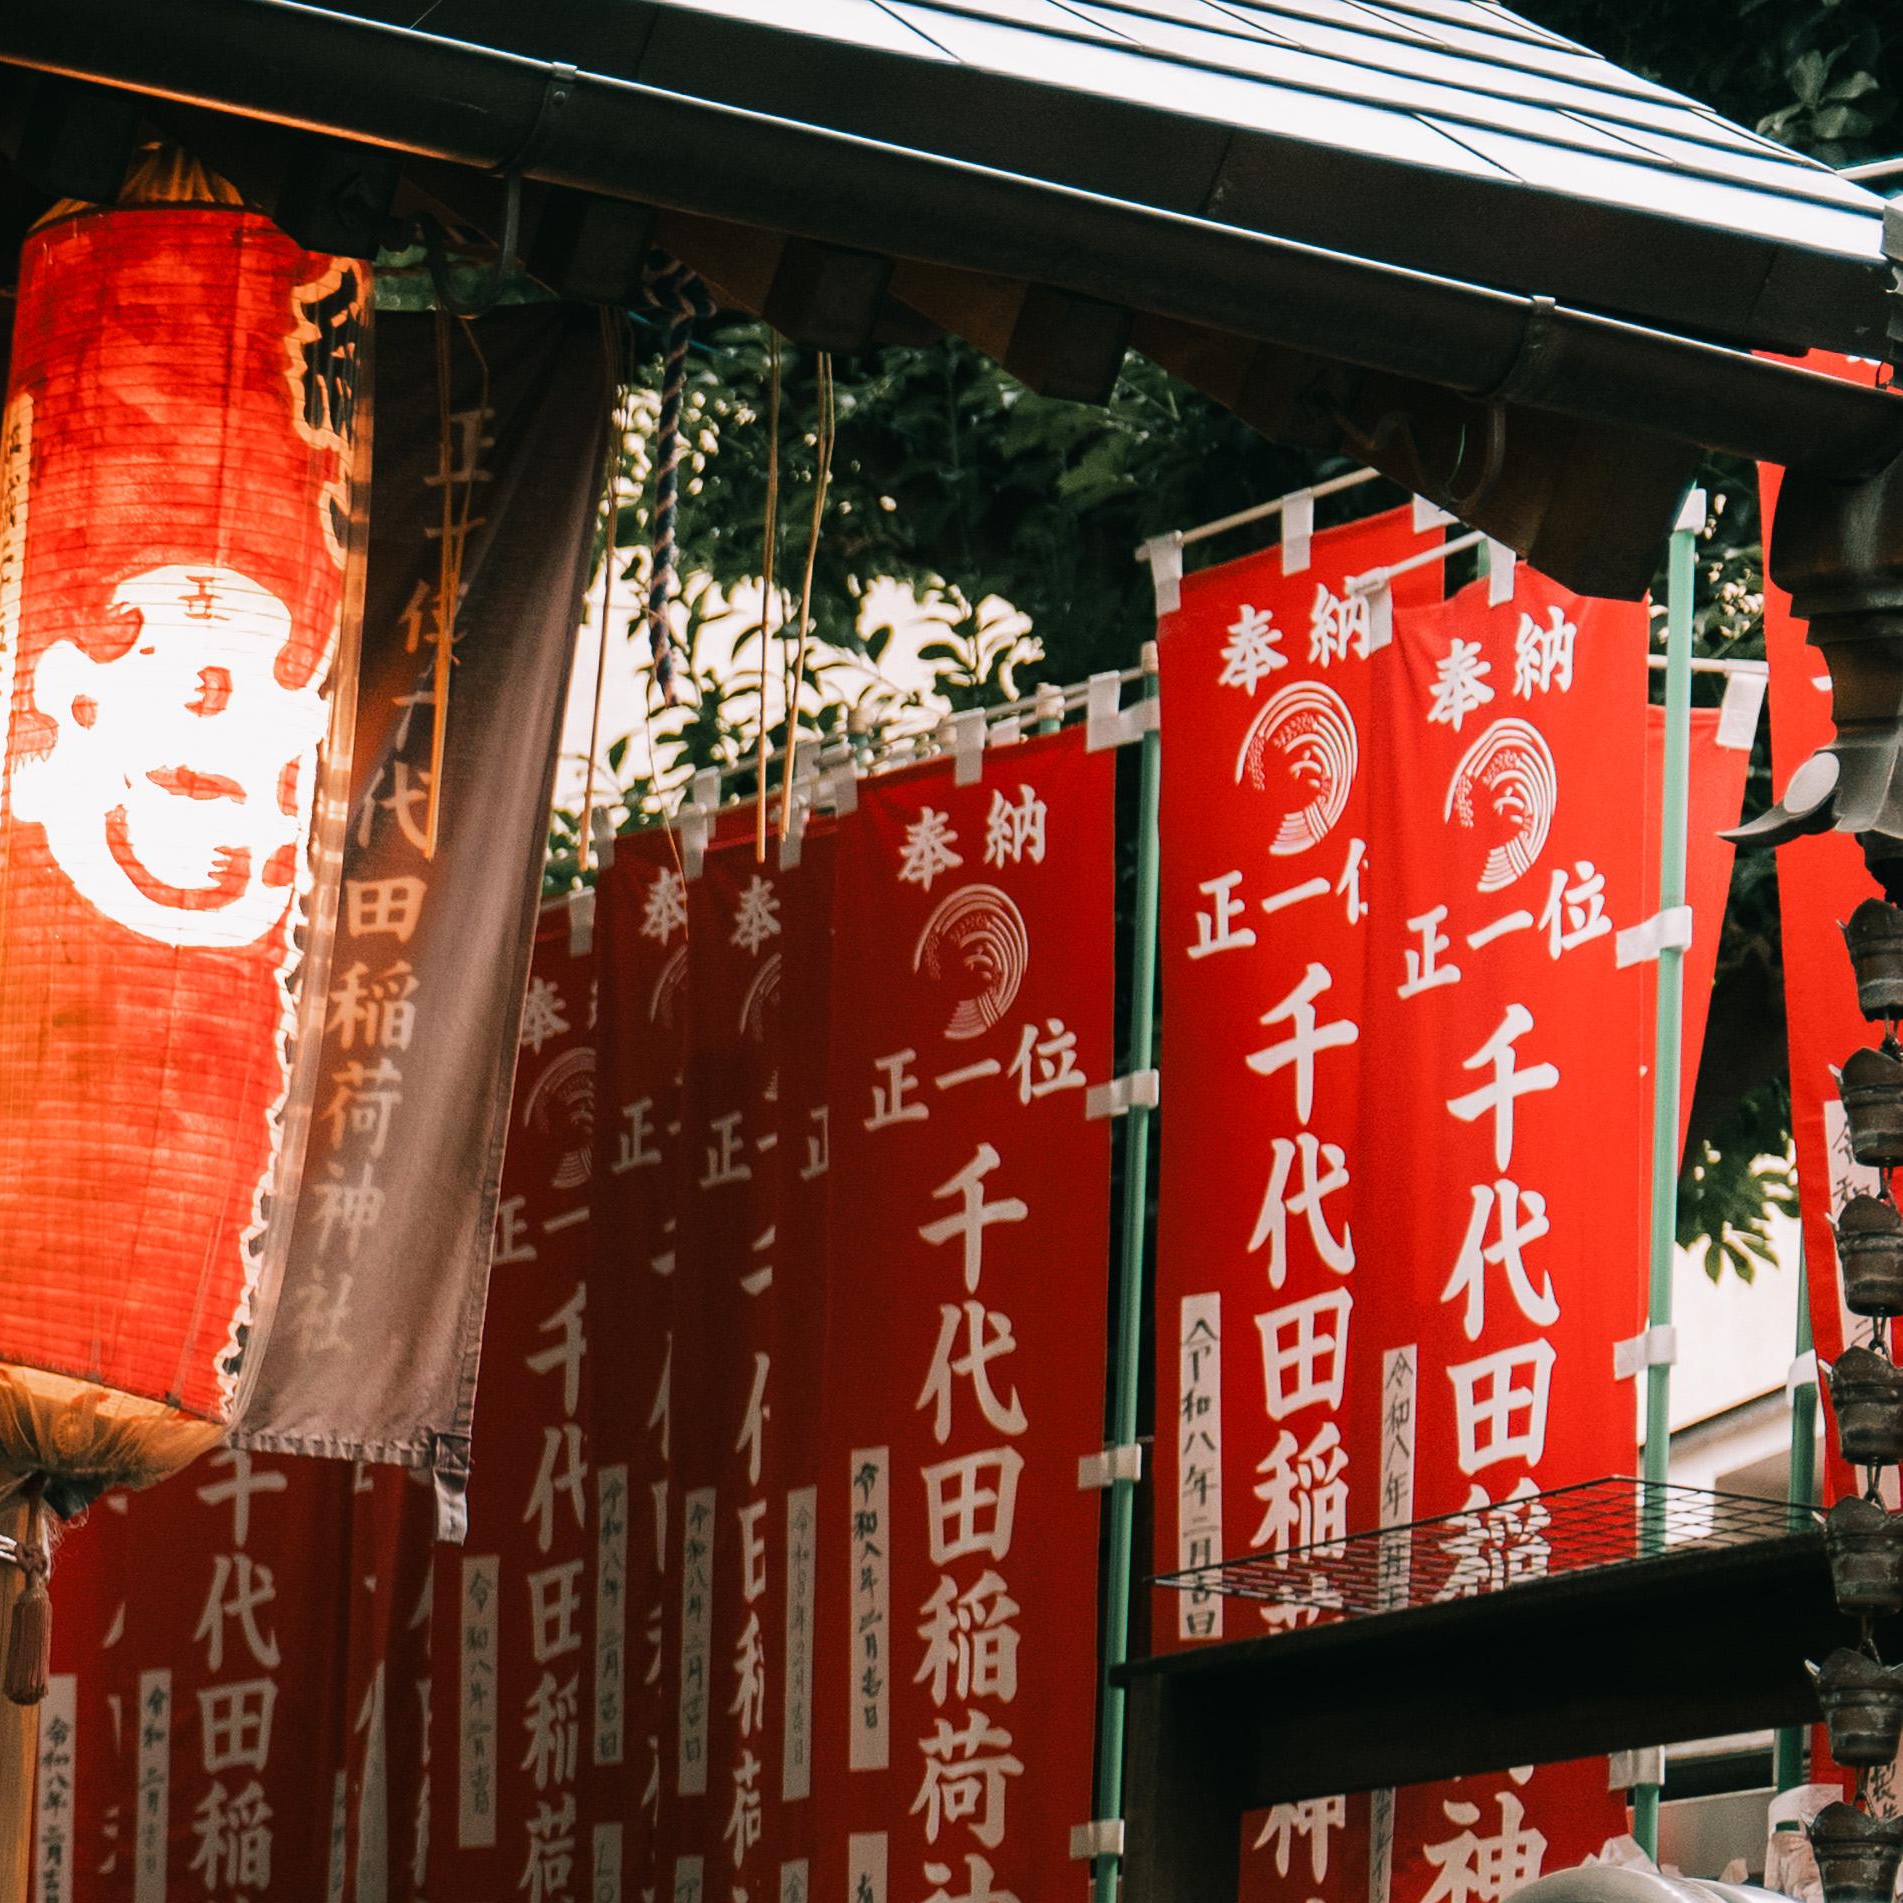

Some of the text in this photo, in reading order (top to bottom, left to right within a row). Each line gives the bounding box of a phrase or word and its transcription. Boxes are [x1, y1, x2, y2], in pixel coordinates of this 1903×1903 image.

[1218, 580, 1372, 697] 奉納
[1429, 606, 1577, 731] 奉納
[899, 784, 1048, 893] 奉納
[1399, 860, 1614, 1000] 正一位
[865, 1017, 1086, 1132] 正一位
[1181, 1318, 1217, 1635] 令和八年二月吉日
[854, 1462, 882, 1729] 令和八年二月吉日
